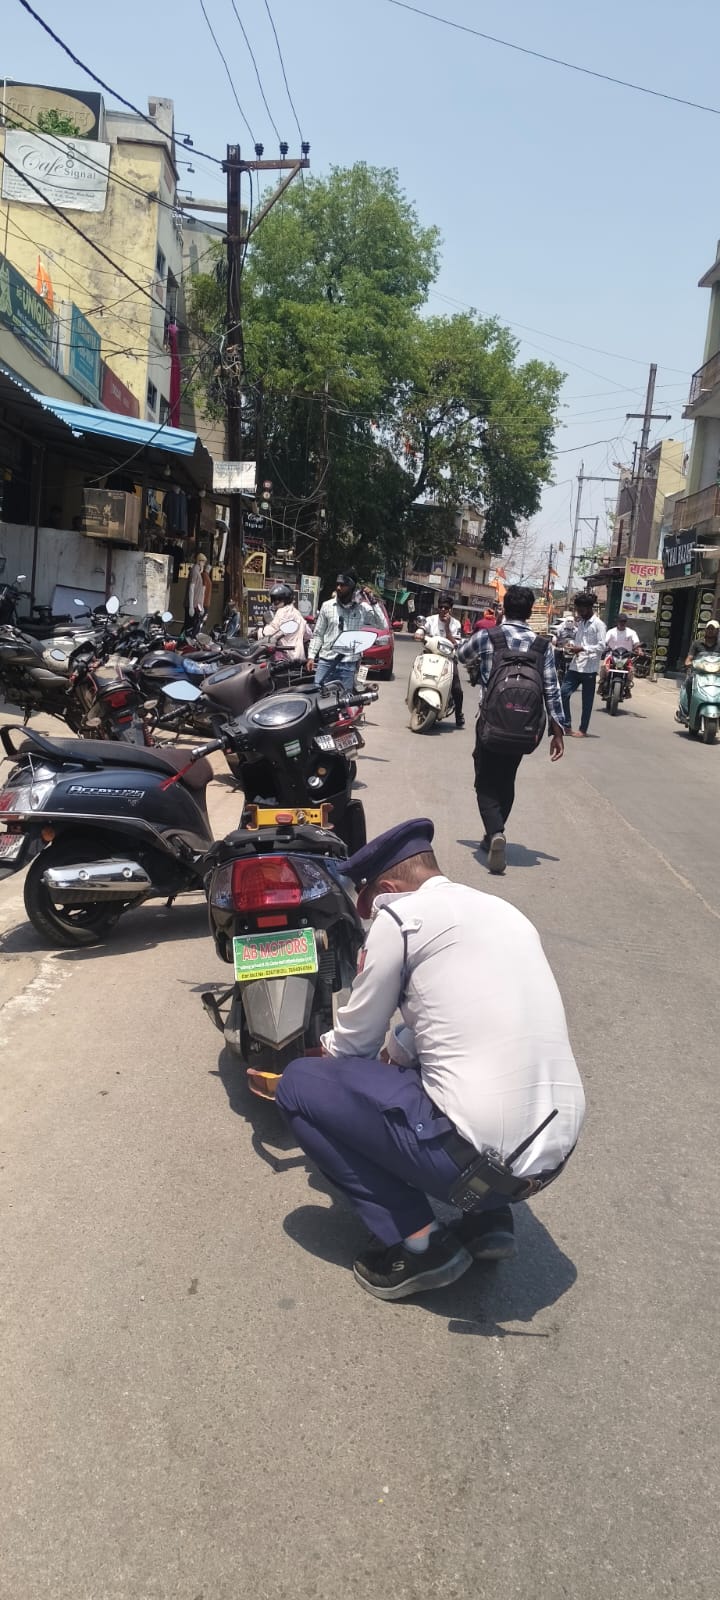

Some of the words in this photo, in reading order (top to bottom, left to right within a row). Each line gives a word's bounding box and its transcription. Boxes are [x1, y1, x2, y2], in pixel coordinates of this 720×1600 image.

[64, 168, 97, 181] Signal
[242, 944, 258, 961] AB
[259, 937, 308, 959] MOTORS
